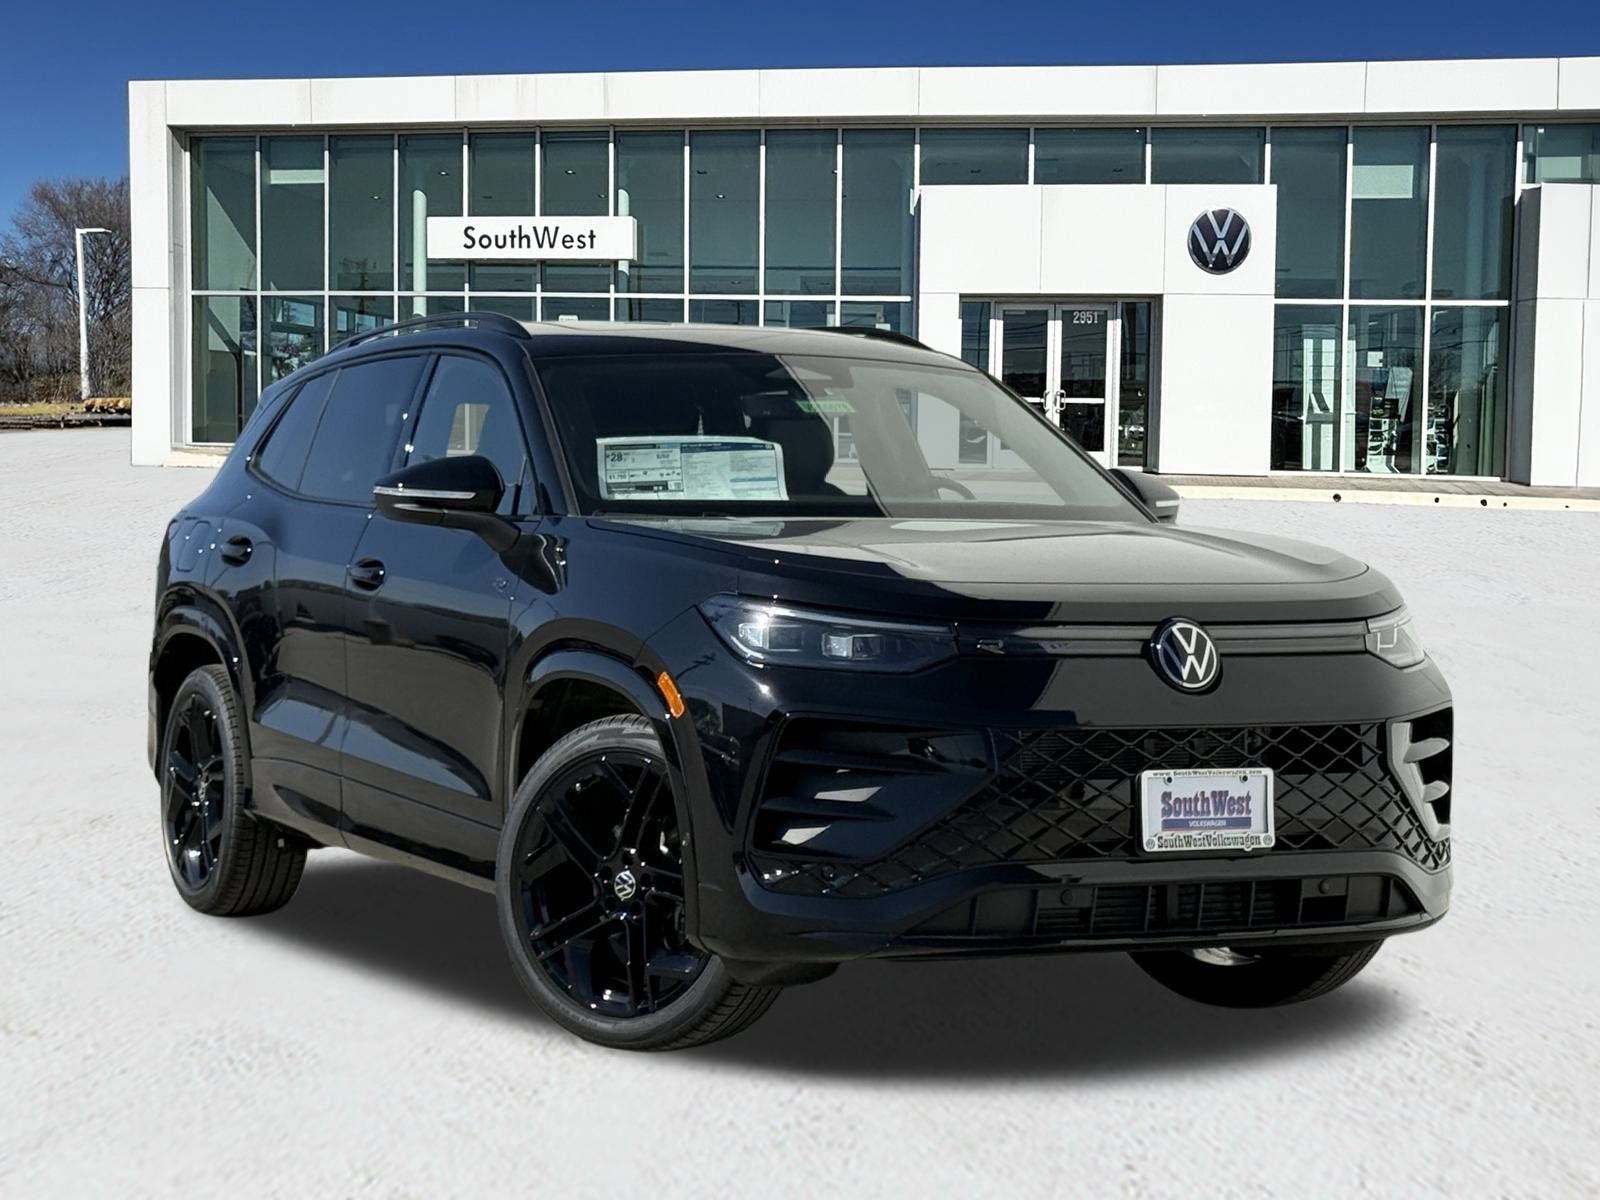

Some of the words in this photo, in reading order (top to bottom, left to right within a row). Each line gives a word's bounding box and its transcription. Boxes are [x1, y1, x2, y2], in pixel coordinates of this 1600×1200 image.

[463, 225, 597, 249] SouthWest
[1161, 790, 1252, 818] SouthWest
[1188, 819, 1227, 828] VOLKSWAGEN
[1157, 832, 1262, 849] SouthWestVolkswagen
